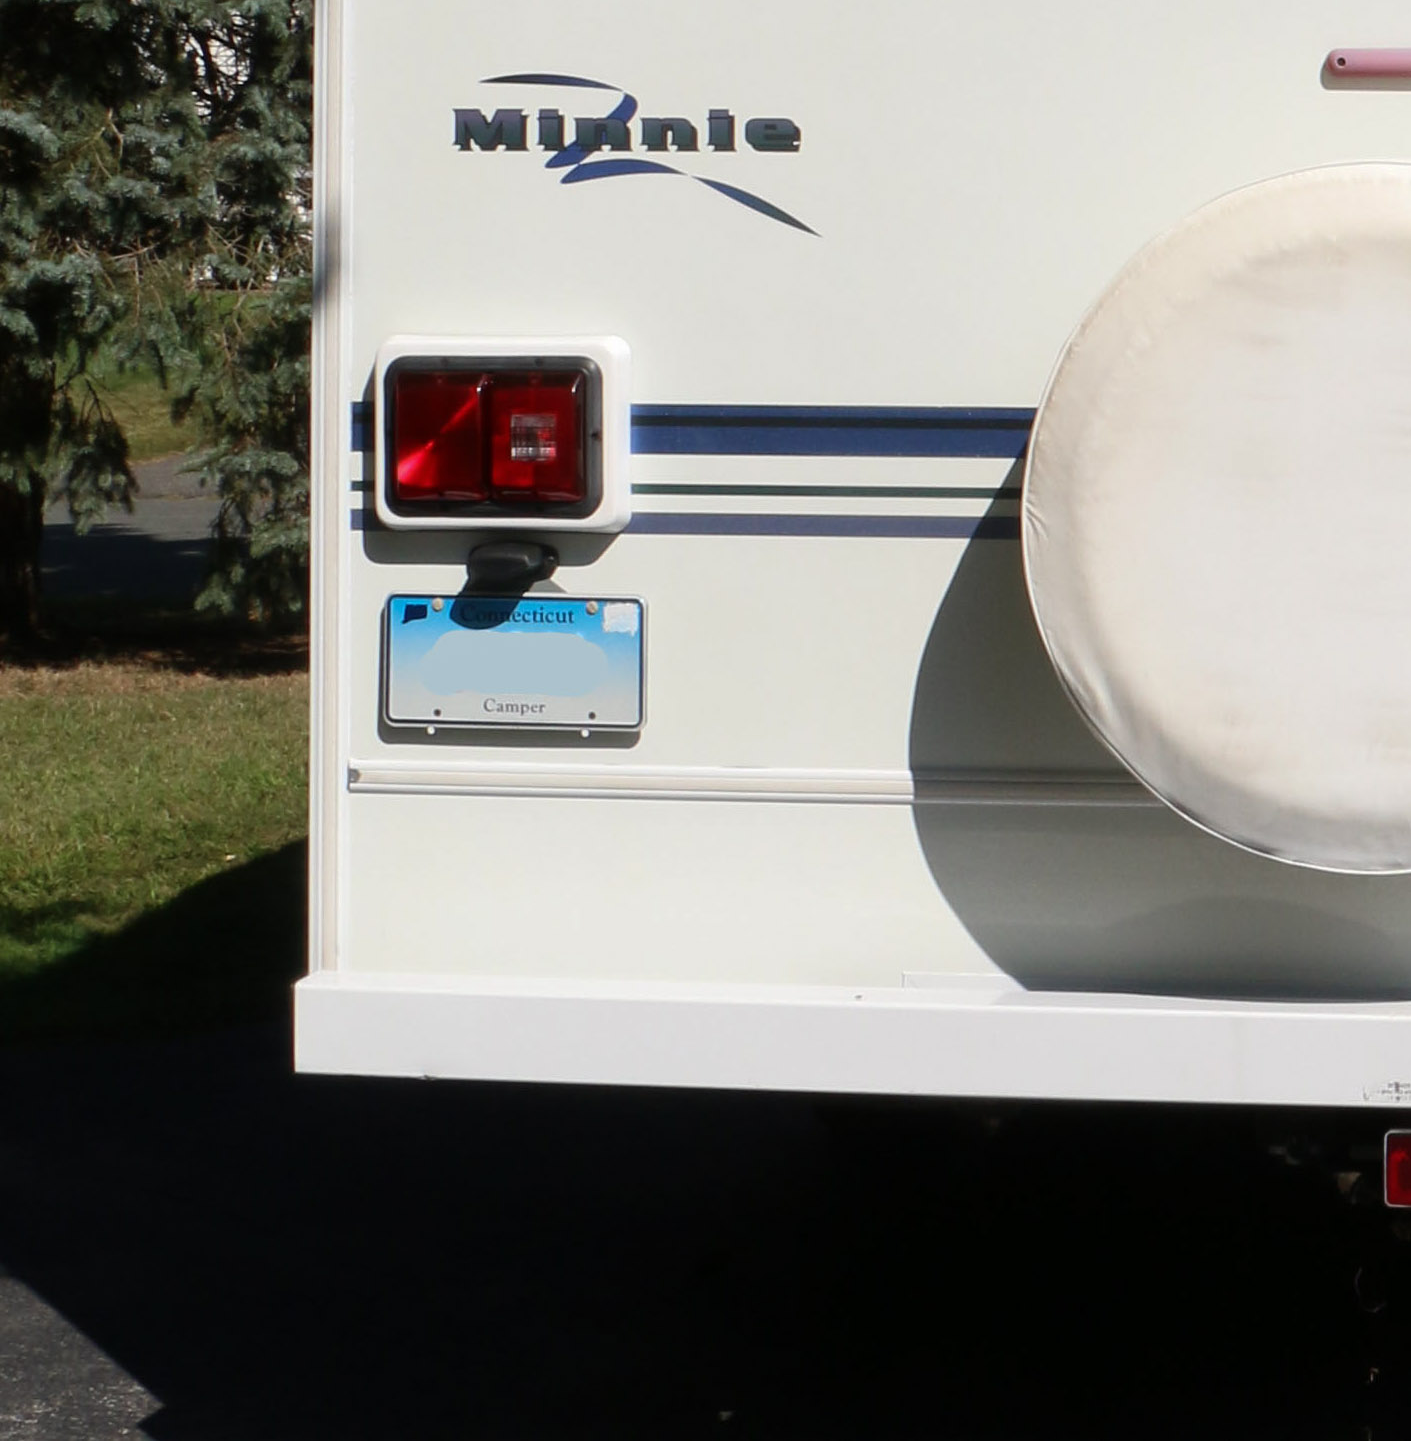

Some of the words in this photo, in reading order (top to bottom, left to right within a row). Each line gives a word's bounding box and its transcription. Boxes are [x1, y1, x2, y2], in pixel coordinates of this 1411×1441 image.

[452, 108, 802, 152] Minnie
[460, 606, 575, 624] Connecticut
[483, 697, 546, 716] Camper
